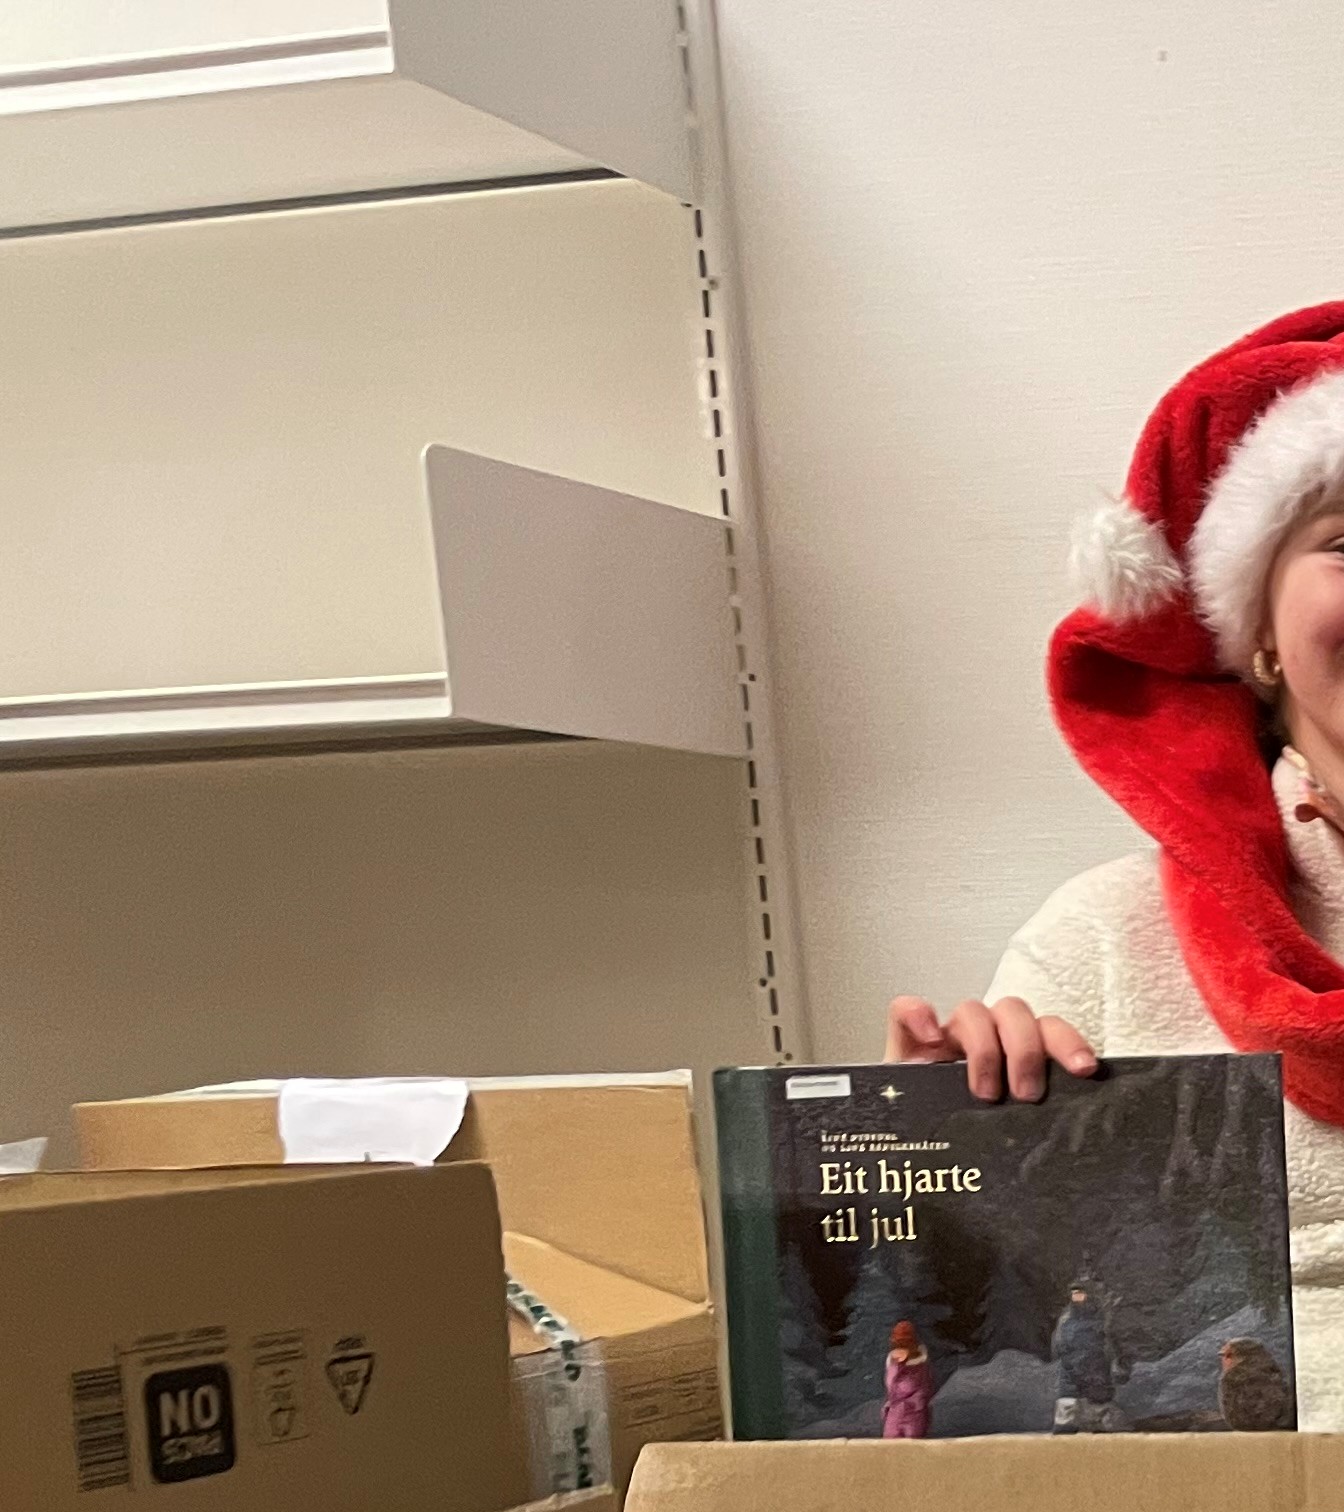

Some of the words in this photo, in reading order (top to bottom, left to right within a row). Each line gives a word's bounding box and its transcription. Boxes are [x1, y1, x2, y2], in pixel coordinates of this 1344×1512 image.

[819, 1160, 870, 1196] Eit
[877, 1159, 982, 1202] hjarte
[820, 1207, 860, 1243] til
[869, 1205, 918, 1250] jul
[159, 1382, 222, 1438] NO
